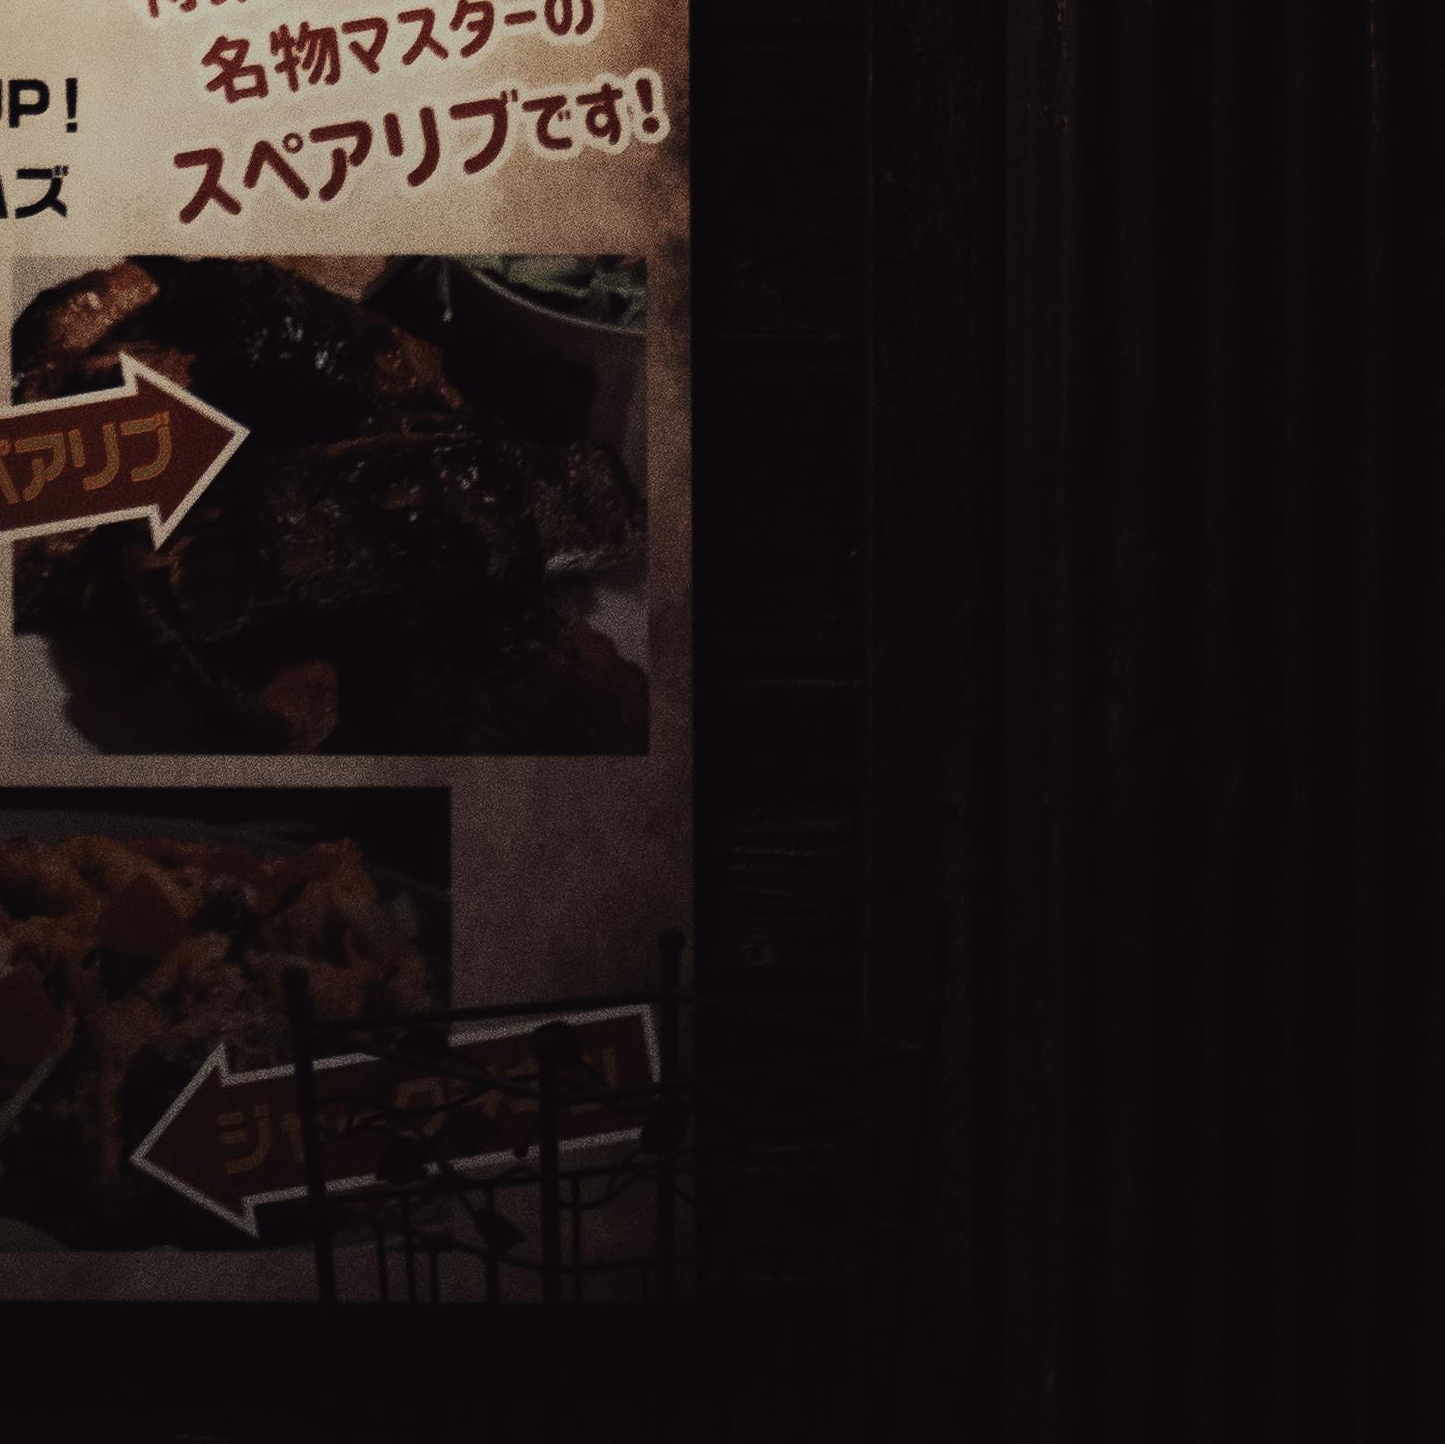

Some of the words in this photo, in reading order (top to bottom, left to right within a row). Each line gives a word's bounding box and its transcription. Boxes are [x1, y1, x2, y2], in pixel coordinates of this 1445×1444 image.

[172, 77, 664, 225] スペアリブです！
